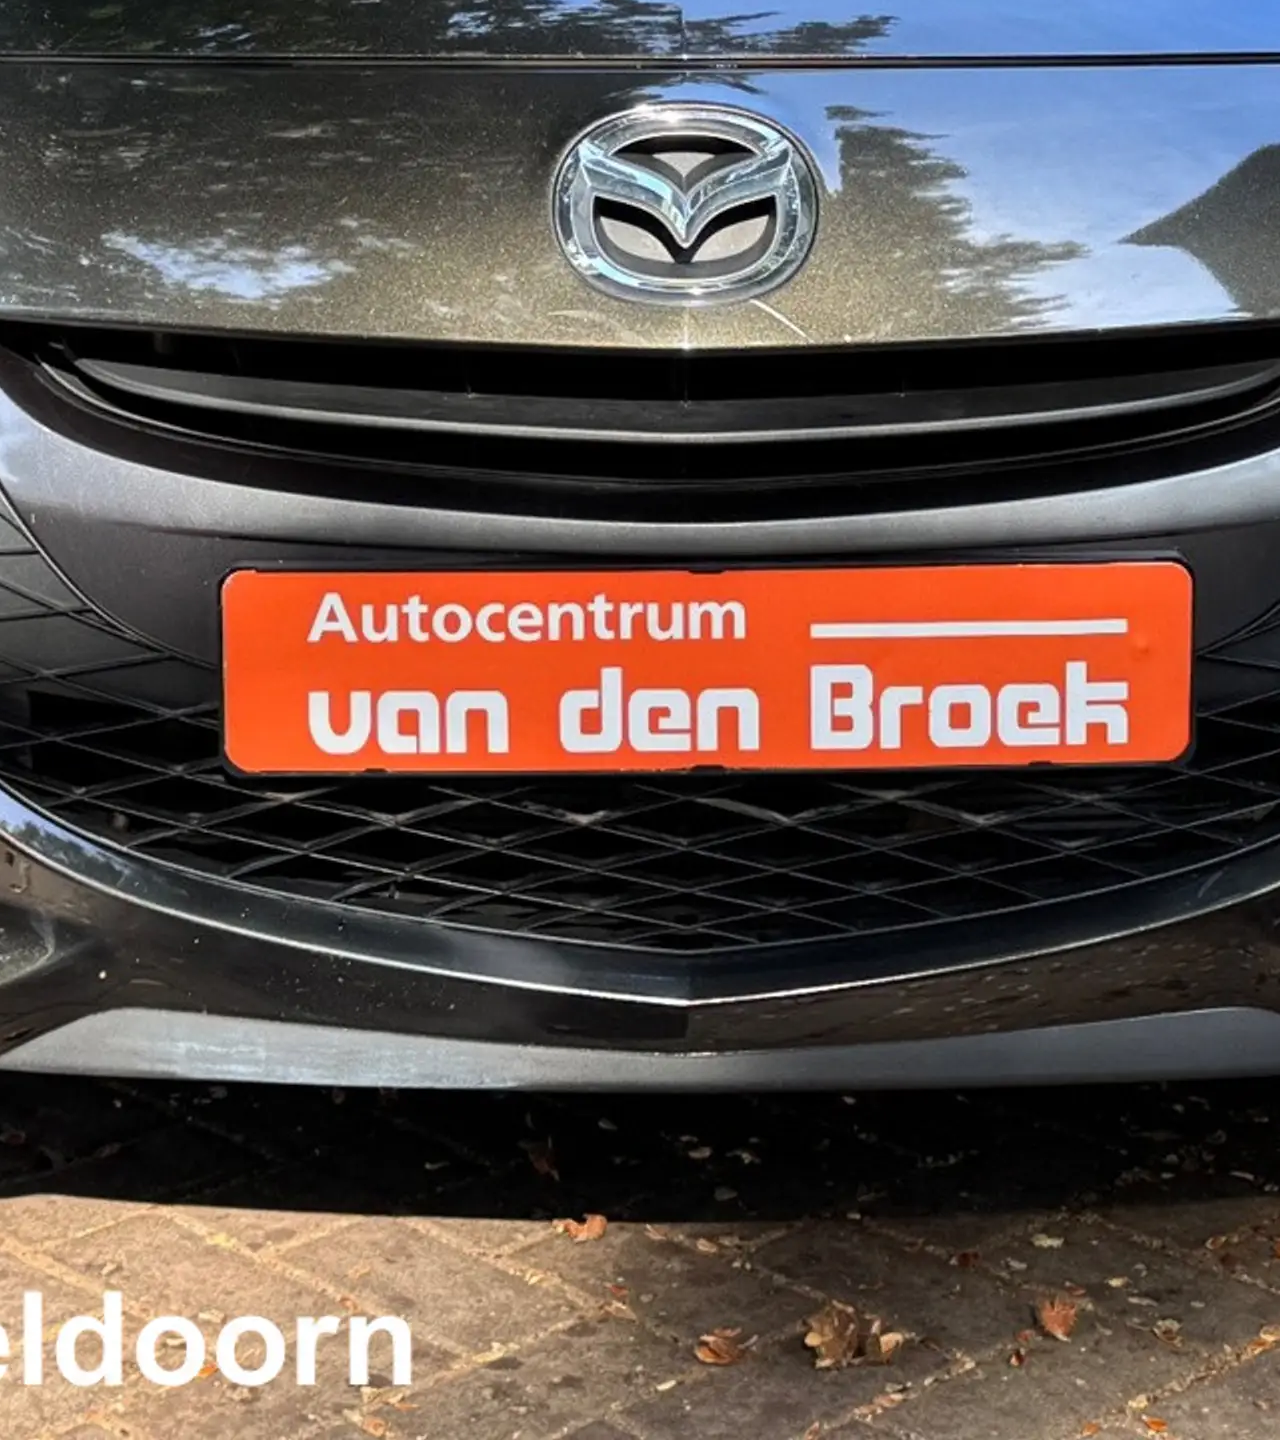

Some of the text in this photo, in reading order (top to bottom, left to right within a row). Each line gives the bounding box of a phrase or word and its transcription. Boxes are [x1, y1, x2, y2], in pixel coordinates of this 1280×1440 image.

[306, 592, 747, 643] Autocentrum
[307, 661, 1130, 755] van den Broek
